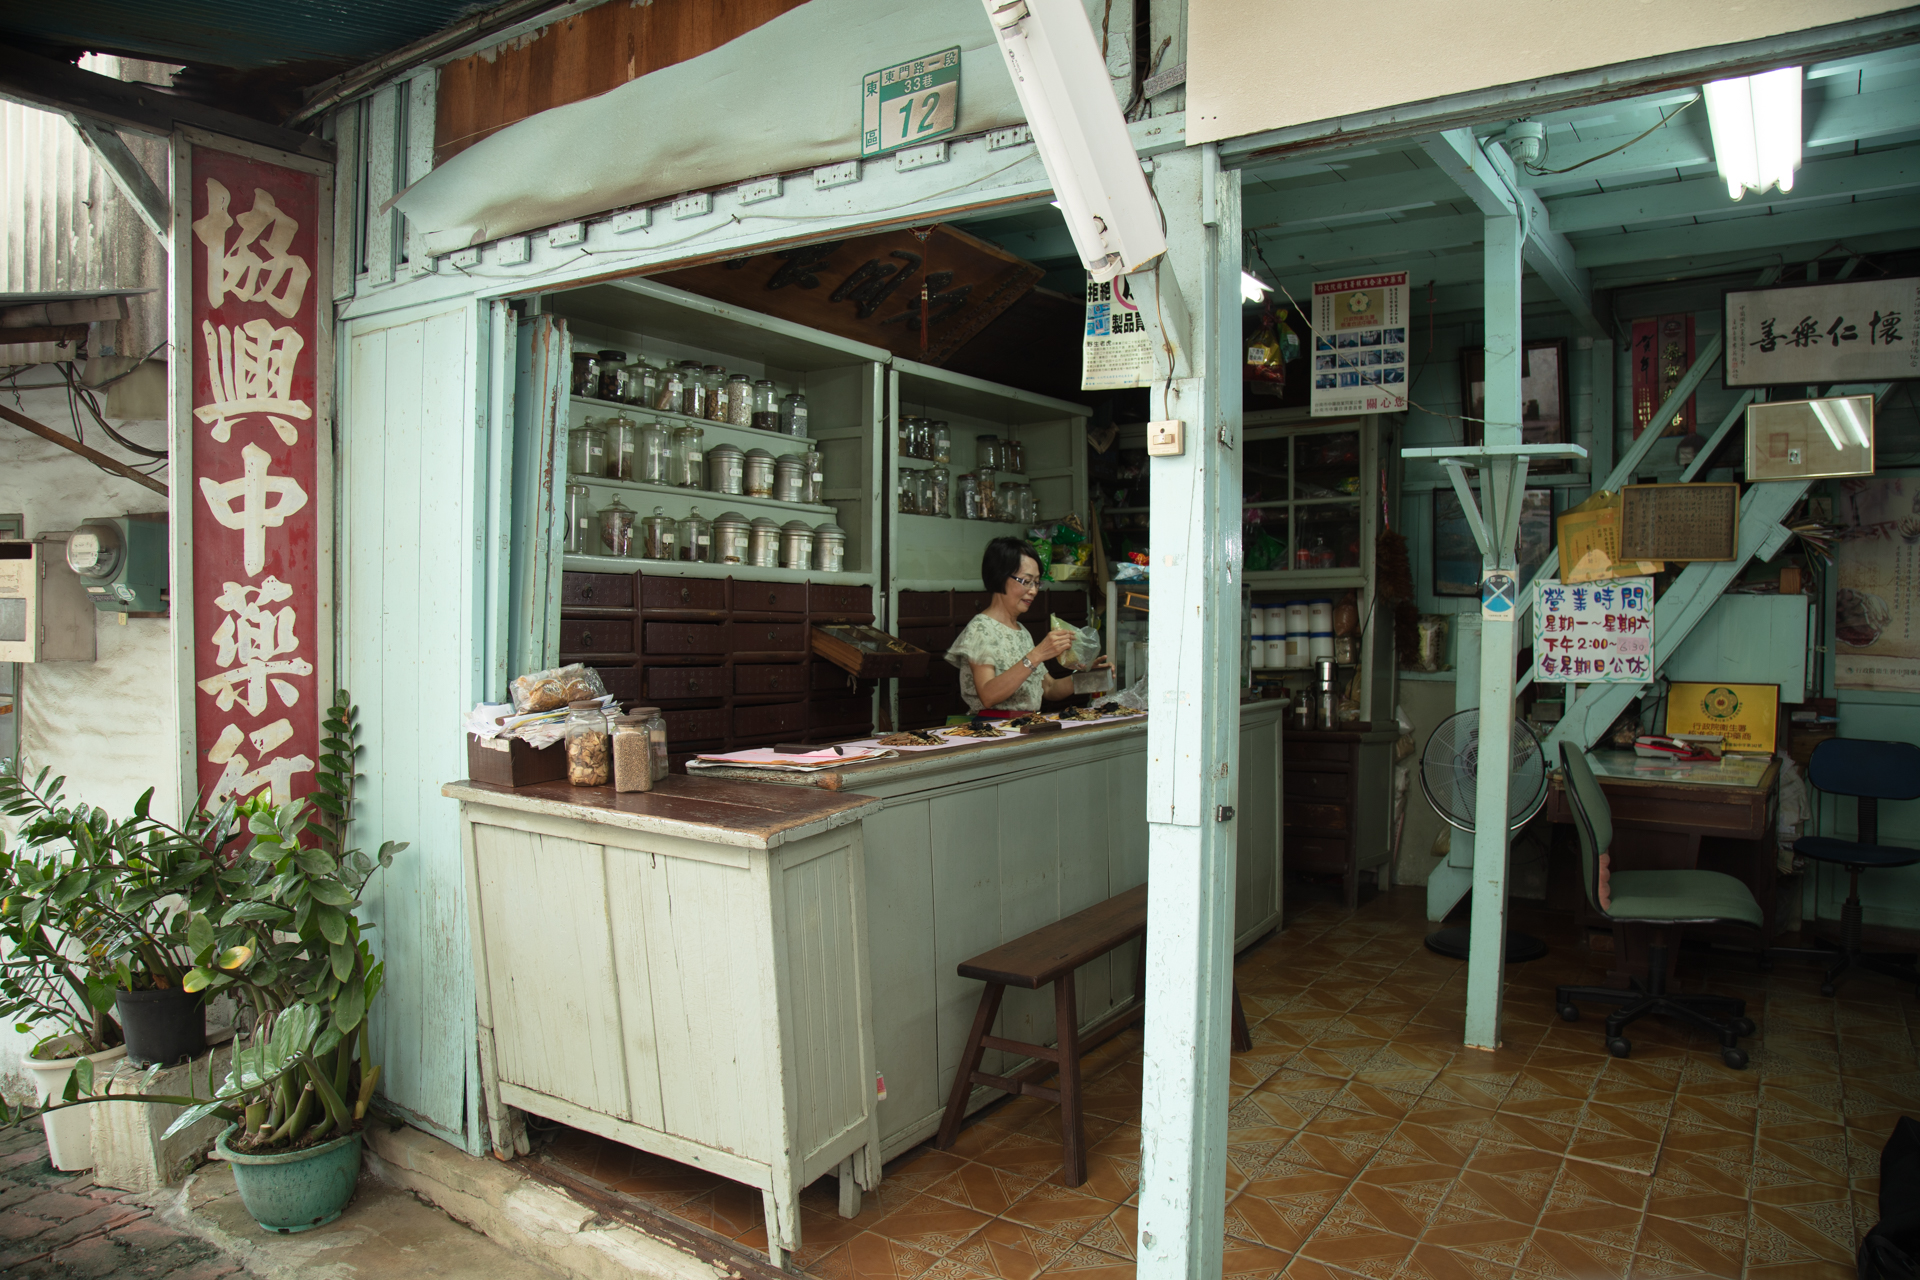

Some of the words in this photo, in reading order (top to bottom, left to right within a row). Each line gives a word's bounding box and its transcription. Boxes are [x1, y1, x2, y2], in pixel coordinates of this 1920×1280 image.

[884, 51, 956, 84] 東門路一段
[904, 74, 933, 93] 33巷
[865, 80, 878, 148] 東區
[899, 92, 940, 138] 12
[193, 177, 315, 812] 協興中藥行
[1544, 586, 1644, 612] 營業時間
[1541, 653, 1648, 676] 每星期日公休
